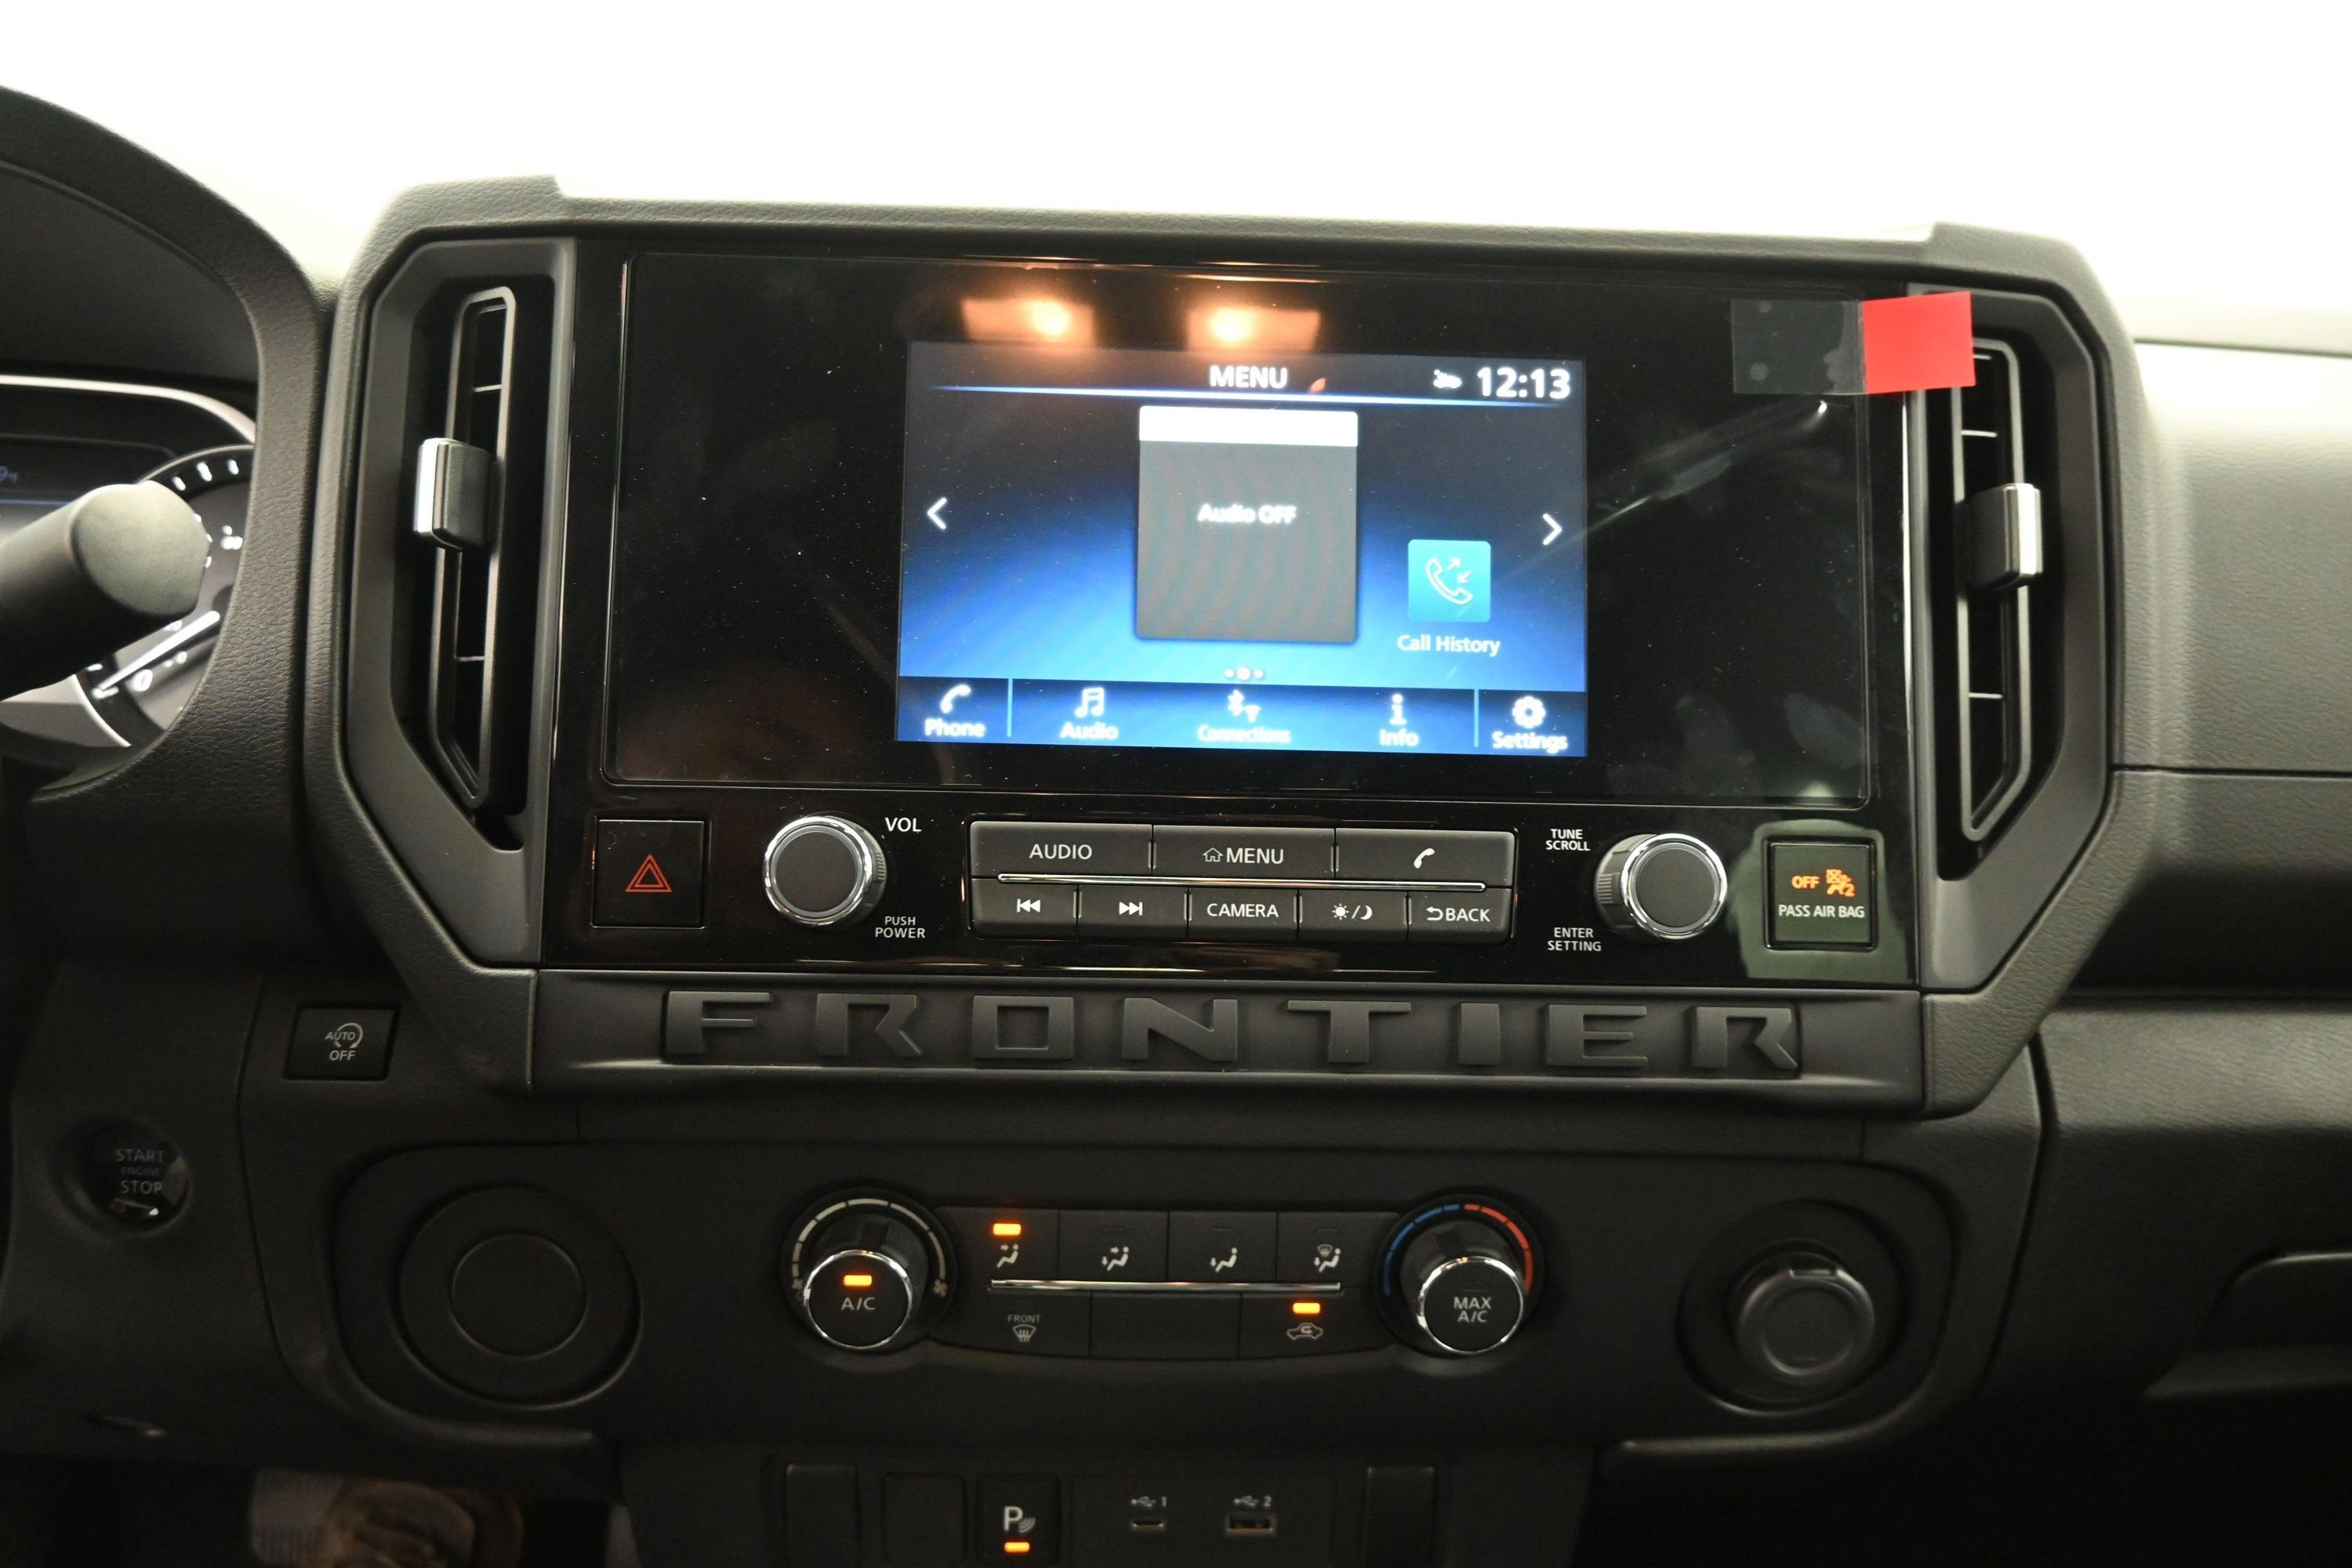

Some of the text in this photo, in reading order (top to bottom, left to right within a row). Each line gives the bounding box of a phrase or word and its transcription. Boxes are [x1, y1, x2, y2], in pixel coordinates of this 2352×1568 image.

[1210, 365, 1288, 389] MENU
[1477, 366, 1571, 399] 12:13
[1197, 503, 1298, 524] Audio OFF
[1397, 635, 1501, 657] Call History
[924, 718, 985, 738] Phone
[1059, 720, 1119, 740] Audio
[1197, 724, 1291, 743] Connections
[1380, 729, 1419, 747] Info
[1492, 731, 1568, 753] Settings
[884, 816, 922, 833] VOL
[1550, 828, 1584, 840] TUNE
[1029, 843, 1093, 861] AUDIO
[1545, 839, 1592, 851] SCROLL
[1225, 847, 1285, 865] MENU
[1791, 875, 1820, 890] OFF
[1207, 902, 1279, 919] CAMERA
[1444, 906, 1491, 924] BACK
[1778, 903, 1866, 919] PASS AIR BAG
[884, 916, 916, 926] PUSH
[875, 927, 926, 938] POWER
[1553, 927, 1594, 939] ENTER
[1547, 939, 1602, 952] SETTING
[325, 1030, 357, 1042] AUTO
[666, 989, 1798, 1071] FRONTIER
[328, 1049, 356, 1062] OFF
[115, 1148, 164, 1163] START
[119, 1179, 163, 1195] STOP
[840, 1297, 876, 1311] A/C
[1454, 1296, 1492, 1309] MAX
[1007, 1313, 1041, 1323] FRONT
[1457, 1310, 1488, 1323] A/C
[1263, 1496, 1272, 1508] 2
